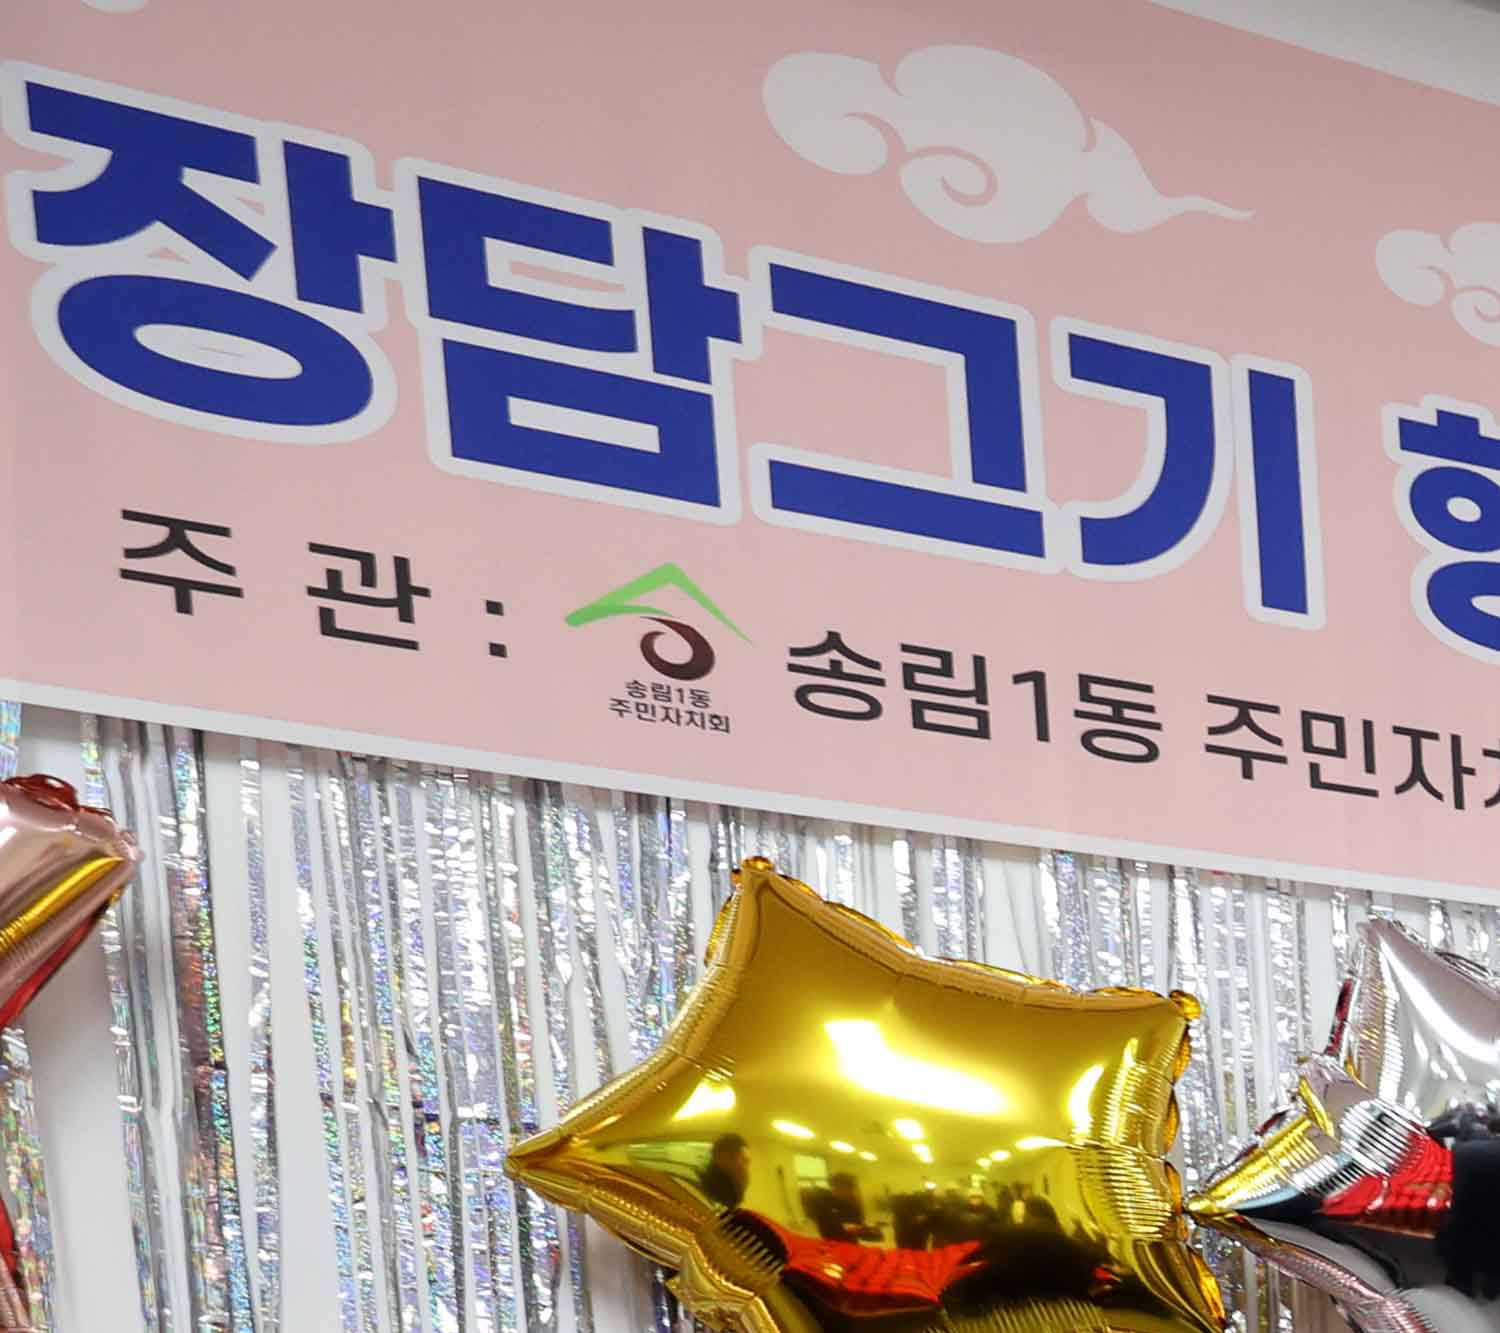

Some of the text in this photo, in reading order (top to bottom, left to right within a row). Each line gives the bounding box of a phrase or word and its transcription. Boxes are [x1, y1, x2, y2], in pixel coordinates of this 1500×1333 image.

[21, 79, 1309, 613] 장담그기
[608, 697, 731, 734] 주민자치회
[624, 679, 712, 709] 송림1동
[784, 629, 1165, 766] 송림1동
